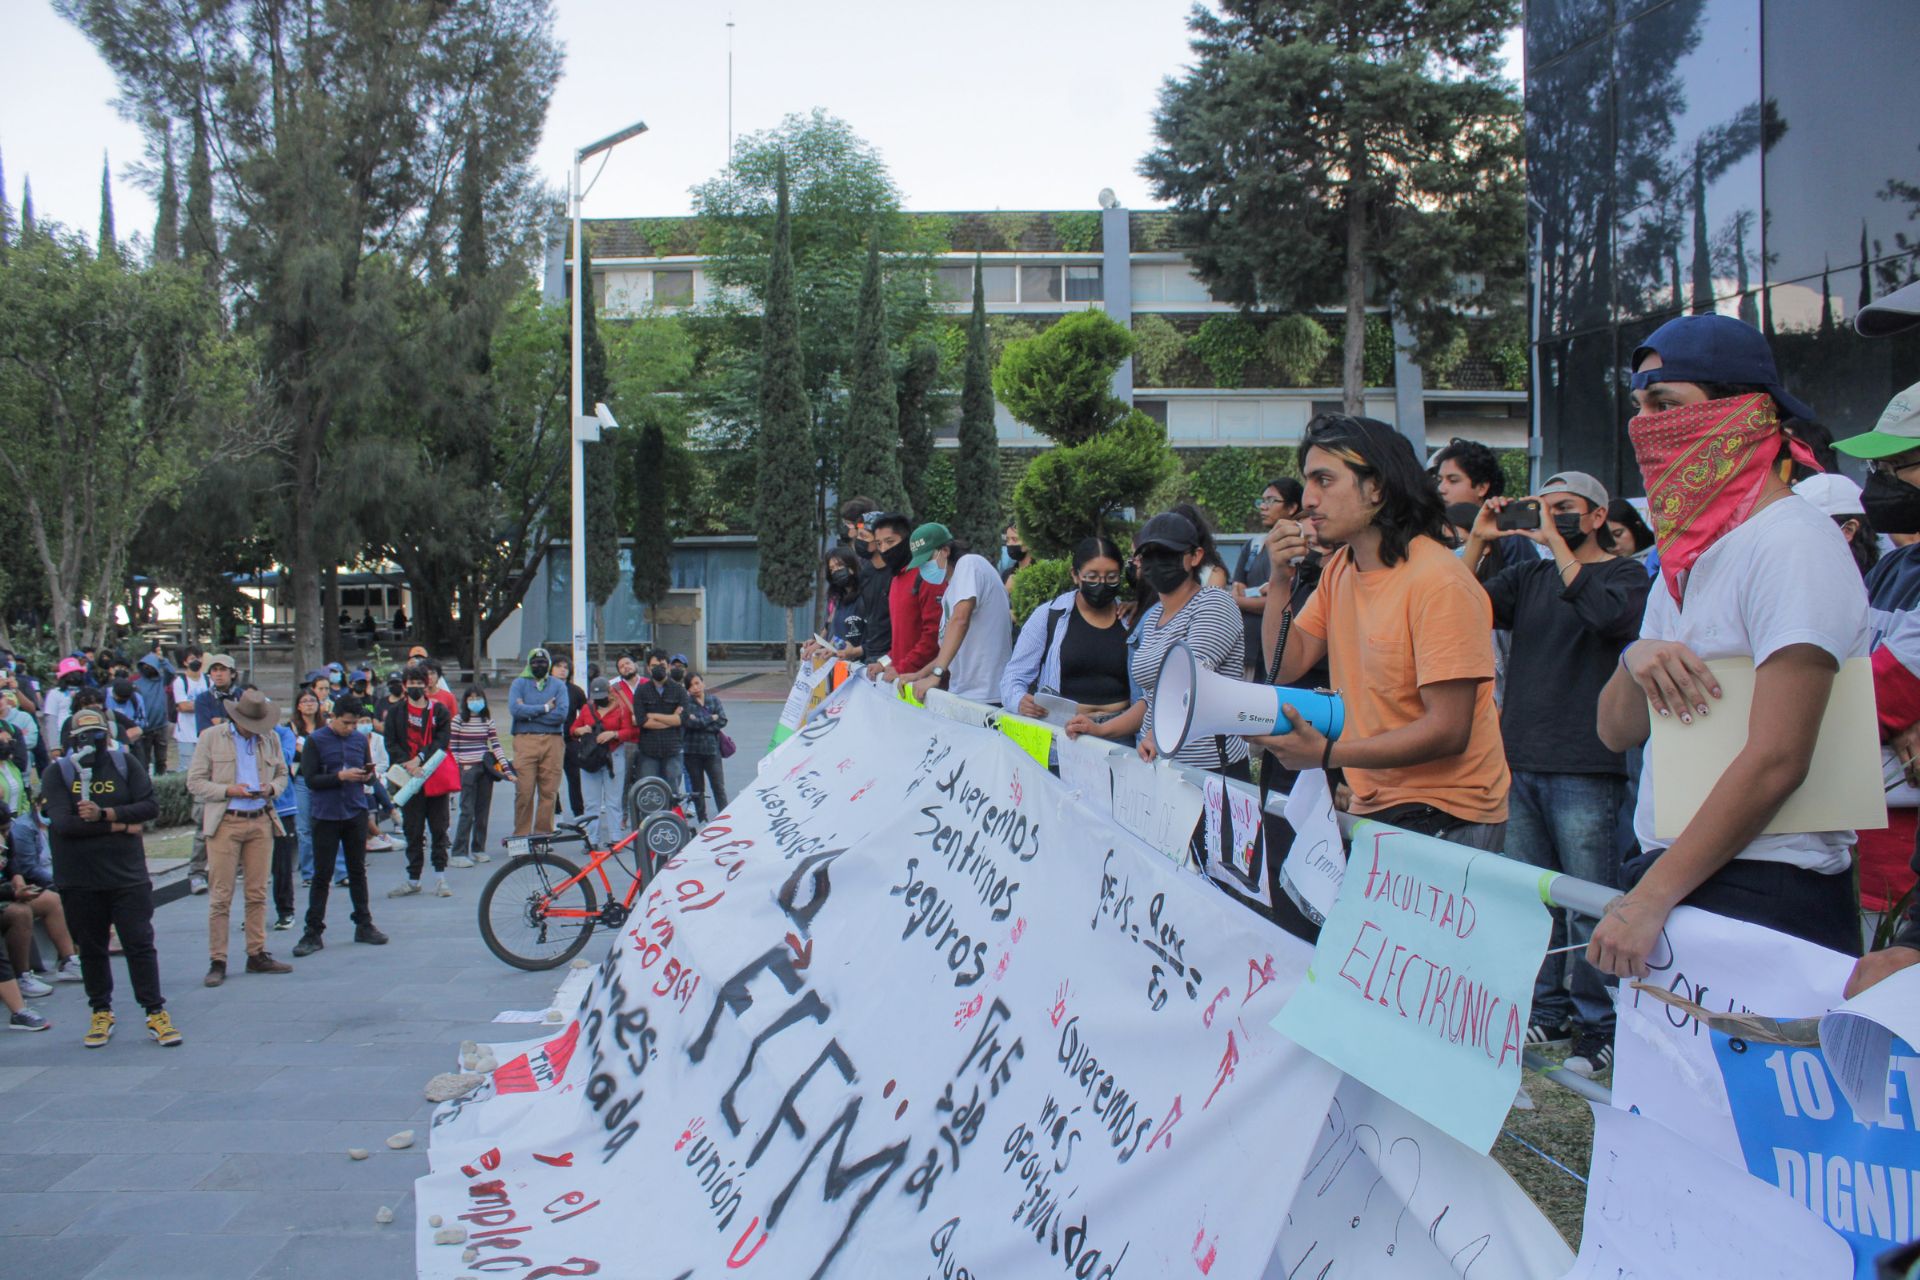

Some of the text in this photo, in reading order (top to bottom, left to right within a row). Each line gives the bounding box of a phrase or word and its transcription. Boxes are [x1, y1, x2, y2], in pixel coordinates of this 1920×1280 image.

[1249, 714, 1275, 724] Steren
[889, 857, 988, 988] Seguros
[1364, 831, 1477, 939] FACULTAD
[529, 1051, 555, 1083] TNT
[1058, 1015, 1153, 1164] Queremos
[1764, 1050, 1835, 1121] 10
[1038, 1090, 1082, 1174] más
[456, 1147, 534, 1273] empleo
[543, 1190, 604, 1224] el
[686, 1136, 742, 1232] unión
